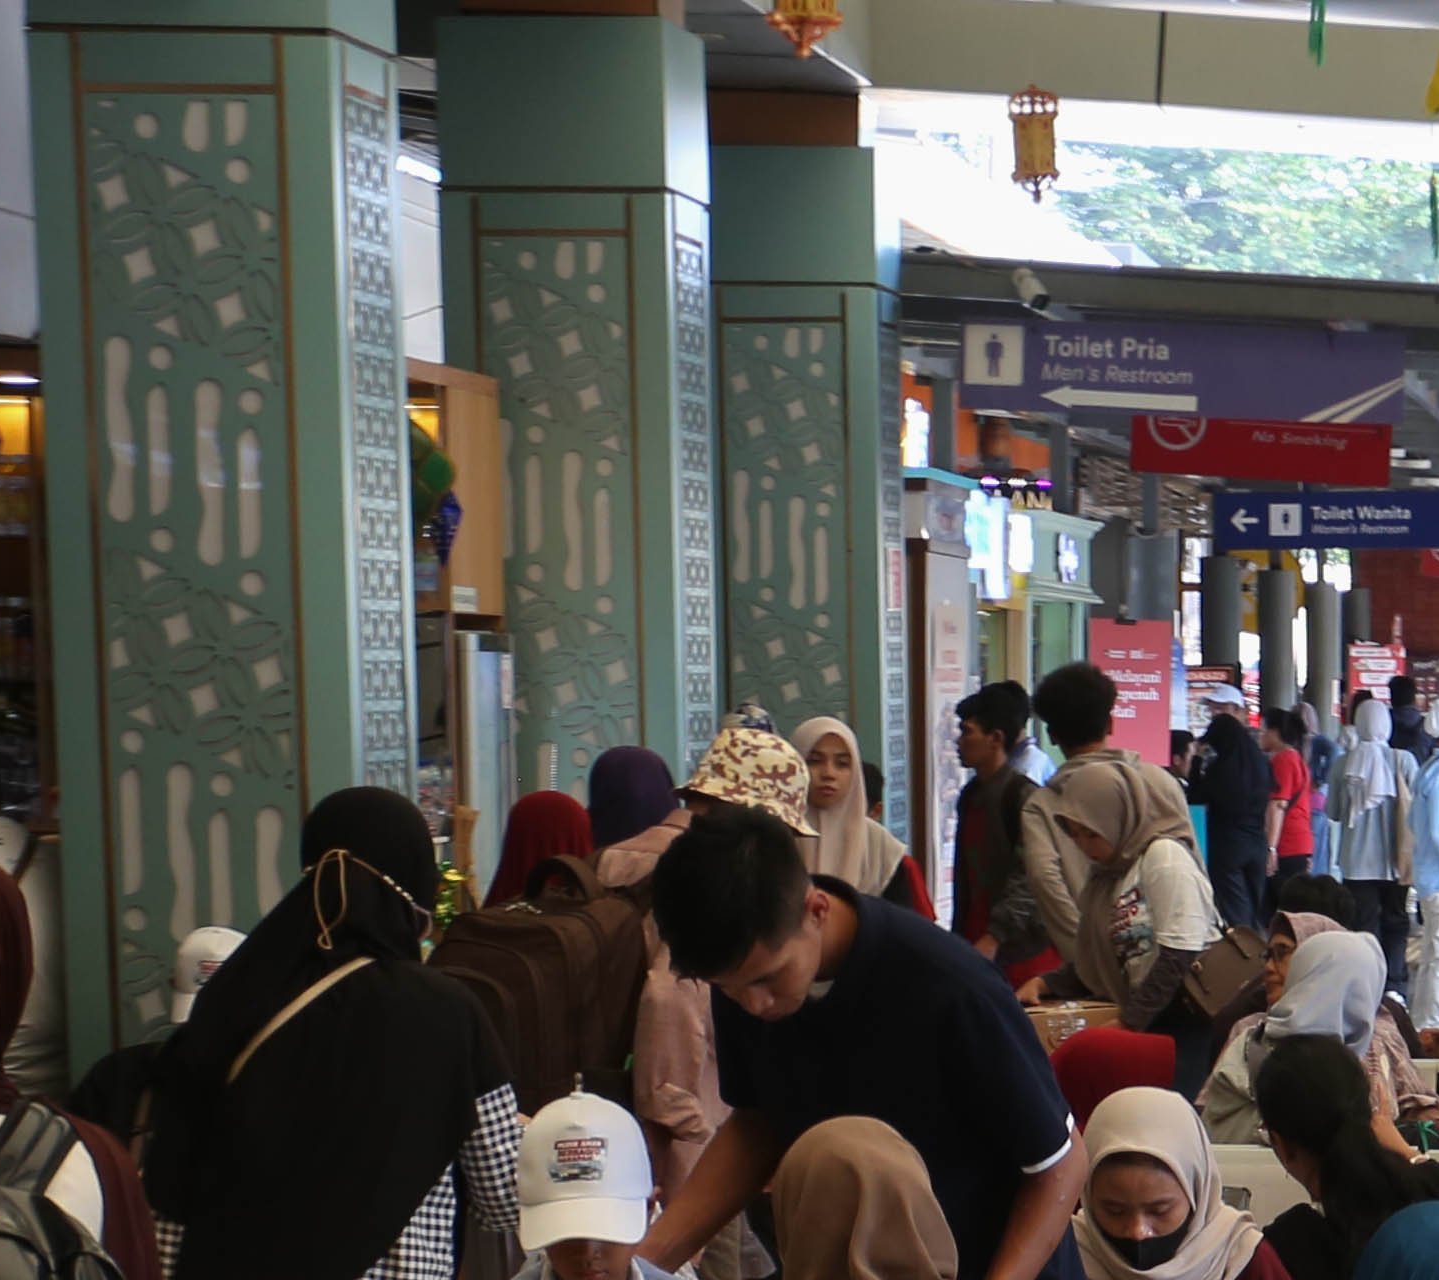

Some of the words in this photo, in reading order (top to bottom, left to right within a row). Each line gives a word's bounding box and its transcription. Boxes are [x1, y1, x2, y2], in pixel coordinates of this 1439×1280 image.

[1043, 335, 1114, 359] Toilet
[1120, 337, 1170, 361] Pria
[1040, 362, 1101, 383] Men's
[1103, 364, 1194, 385] Restroom
[1251, 430, 1275, 443] No
[1281, 432, 1348, 451] Smoking
[1309, 505, 1354, 520] Toilet
[1355, 505, 1412, 520] Wanita
